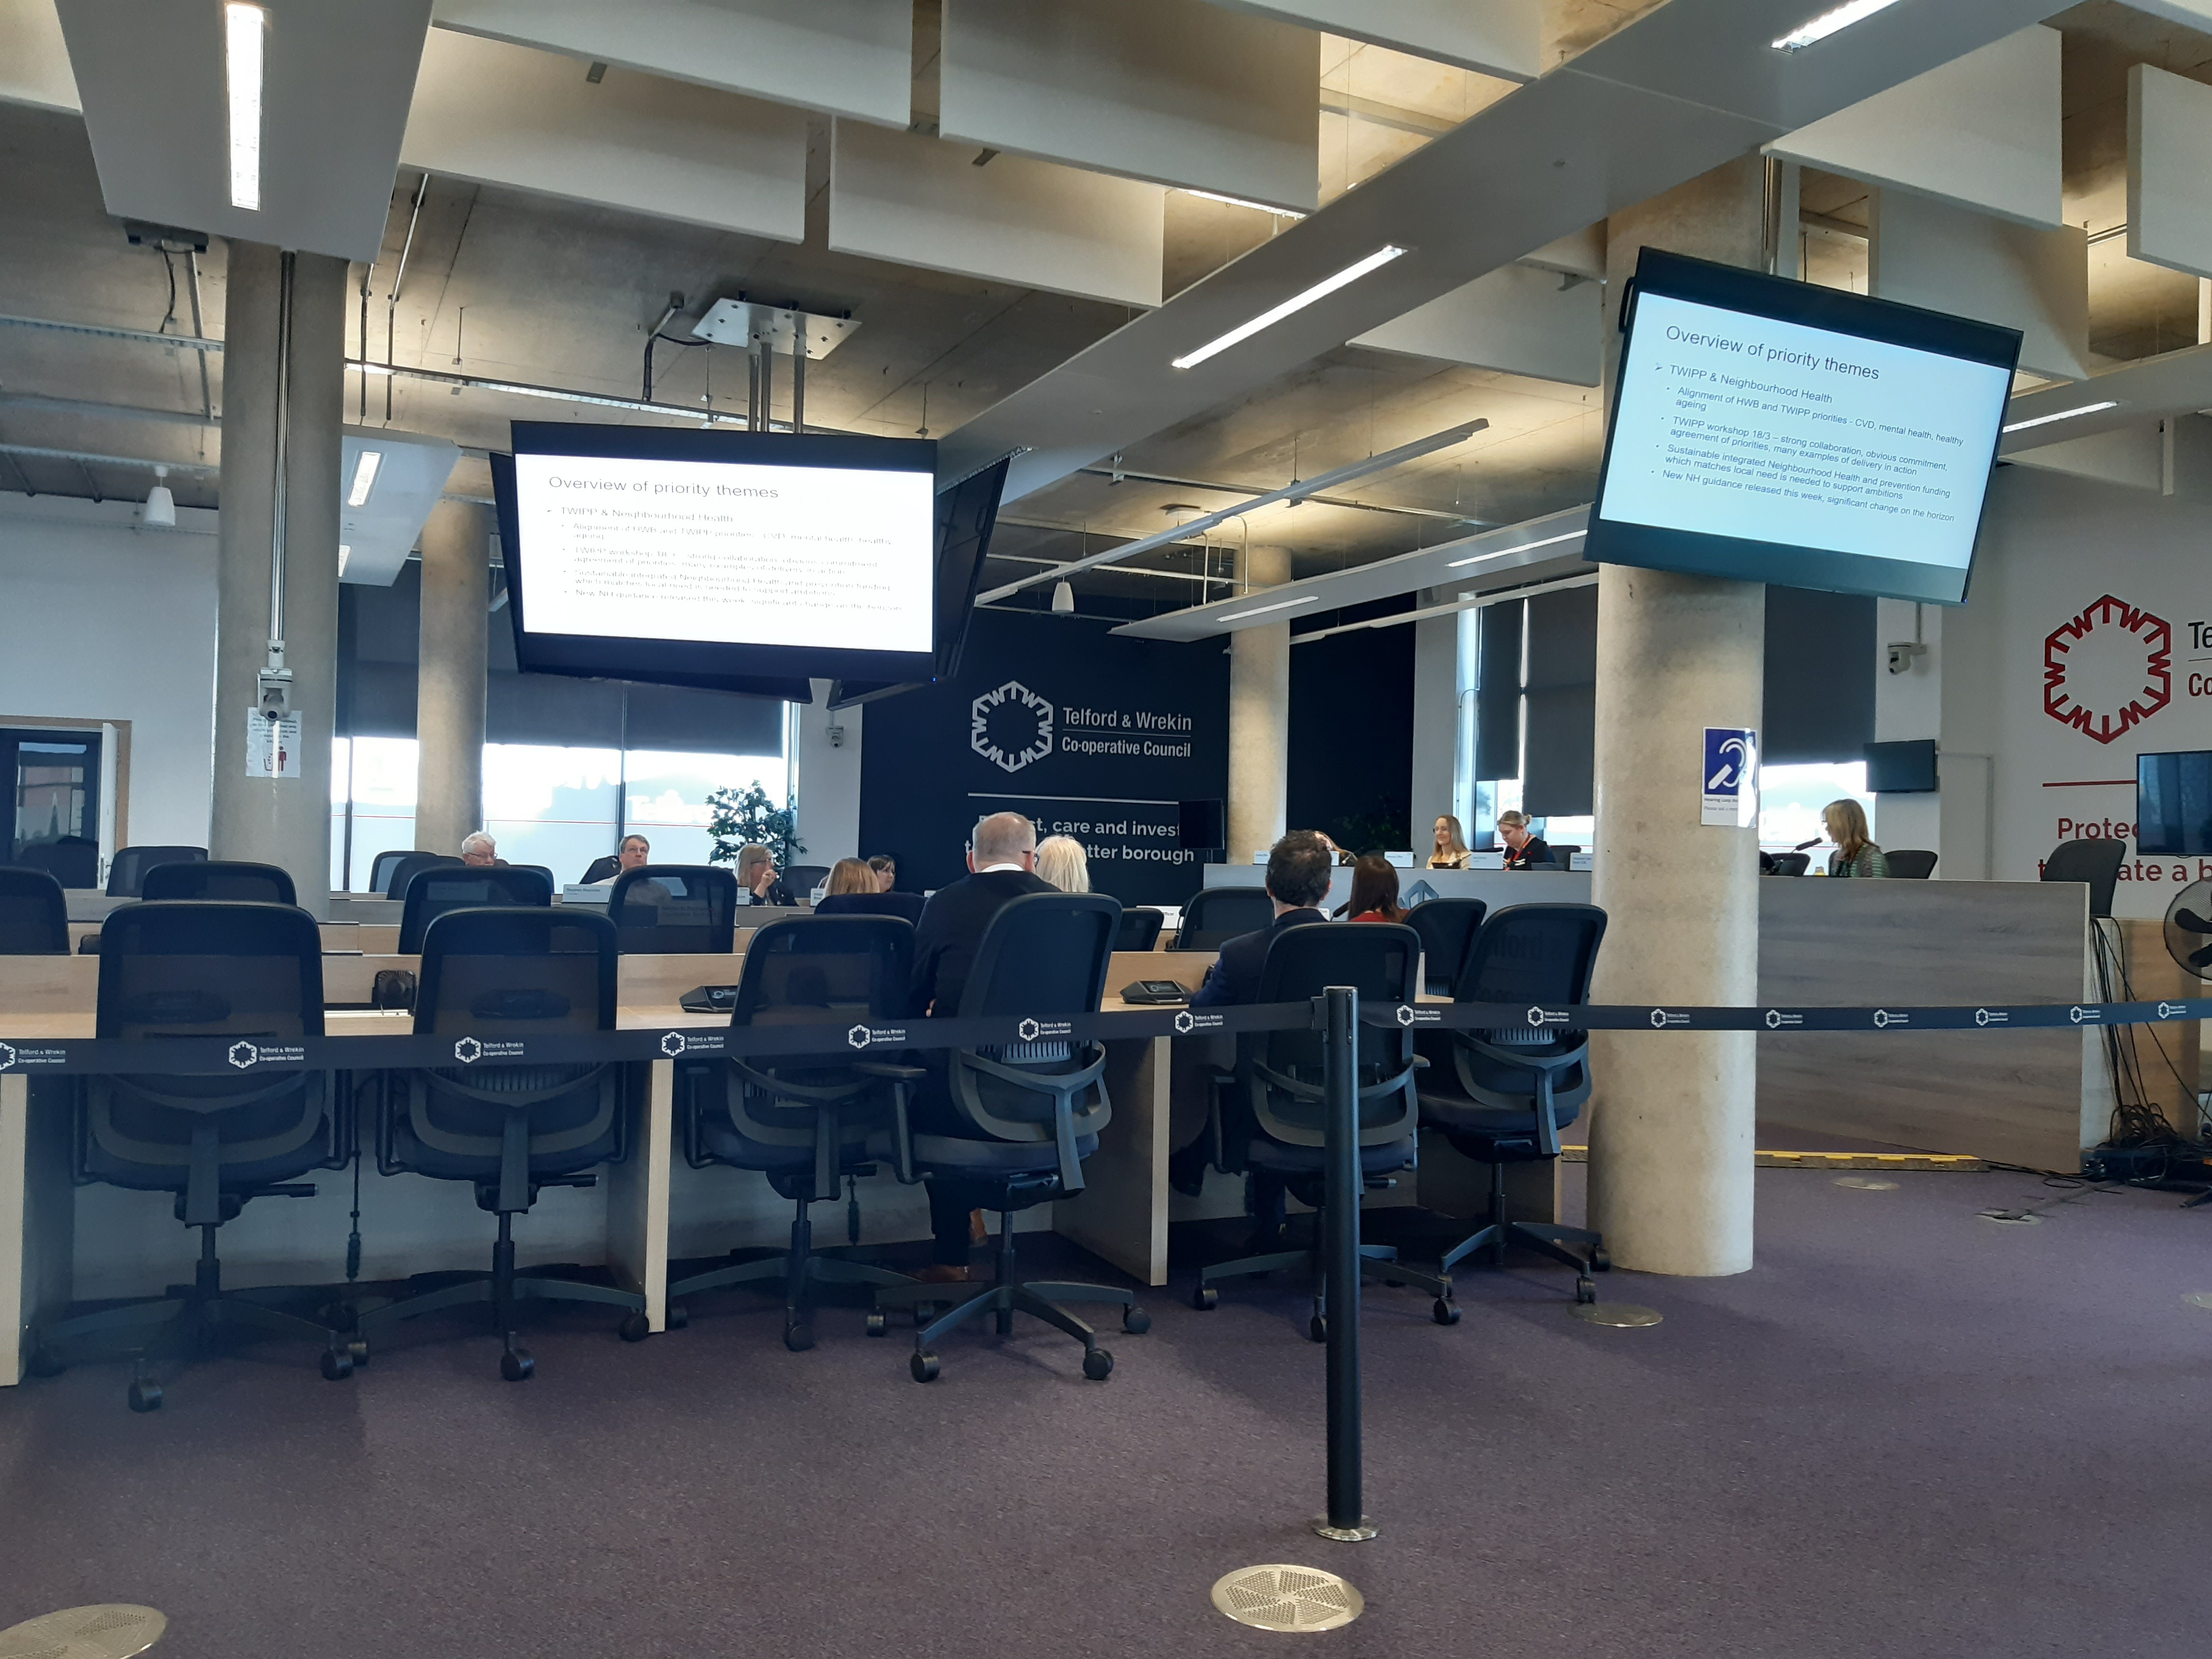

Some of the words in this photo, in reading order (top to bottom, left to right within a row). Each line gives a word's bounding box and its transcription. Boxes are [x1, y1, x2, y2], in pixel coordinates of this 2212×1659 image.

[1666, 325, 1744, 353] Overview
[1747, 343, 1765, 357] of
[1766, 348, 1821, 371] priority
[1824, 356, 1880, 380] themes
[1670, 364, 1708, 380] TWIPP
[1709, 372, 1718, 383] &
[1719, 373, 1799, 397] Neighbourhood
[1800, 389, 1833, 404] Health
[1675, 398, 1707, 412] ageing
[1677, 386, 1724, 402] Alignment
[1725, 395, 1736, 404] of
[1736, 397, 1760, 409] HWB
[1761, 403, 1779, 412] and
[1780, 404, 1811, 417] TWIPP
[1811, 411, 1848, 425] priorities
[1878, 424, 1907, 435] mental
[1935, 433, 1964, 447] healthy
[1670, 428, 1719, 443] agreement
[1720, 435, 1731, 445] of
[1773, 445, 1798, 457] many
[1798, 450, 1839, 463] examples
[1840, 456, 1851, 464] of
[1851, 457, 1883, 471] delivery
[1884, 462, 1892, 472] in
[1893, 466, 1918, 476] action
[1672, 415, 1706, 429] TWIPP
[1707, 423, 1750, 439] workshop
[1752, 429, 1771, 441] 18/3
[1780, 435, 1808, 449] strong
[1865, 449, 1898, 462] obvious
[548, 476, 627, 491] Overview
[632, 481, 649, 492] of
[654, 481, 711, 498] priority
[716, 484, 779, 498] themes
[1665, 455, 1692, 467] which
[1693, 460, 1732, 473] matches
[1733, 465, 1755, 476] local
[1755, 470, 1779, 480] need
[1779, 472, 1788, 481] is
[1789, 475, 1822, 487] needed
[1822, 479, 1831, 488] to
[1832, 482, 1864, 494] support
[1864, 488, 1904, 500] ambitions
[1667, 444, 1720, 460] Sustainable
[1721, 452, 1767, 468] integrated
[1767, 459, 1833, 478] Neighbourhood
[1833, 470, 1861, 483] Health
[1862, 477, 1879, 486] and
[1878, 480, 1921, 493] prevention
[1922, 485, 1951, 499] funding
[1662, 469, 1684, 481] New
[1684, 472, 1701, 483] NH
[1702, 477, 1743, 490] guidance
[1744, 483, 1782, 495] released
[1783, 488, 1799, 498] this
[1827, 495, 1868, 509] significant
[1869, 501, 1899, 515] change
[1900, 507, 1911, 516] on
[1912, 508, 1925, 517] the
[1926, 510, 1955, 522] horizon
[1062, 707, 1117, 728] Telford
[1121, 713, 1131, 729] &
[1136, 711, 1192, 731] Wrekin
[1143, 742, 1191, 757] Council
[1053, 821, 1090, 834] care
[1095, 820, 1127, 835] and
[1122, 846, 1194, 865] borough
[2172, 866, 2188, 882] a
